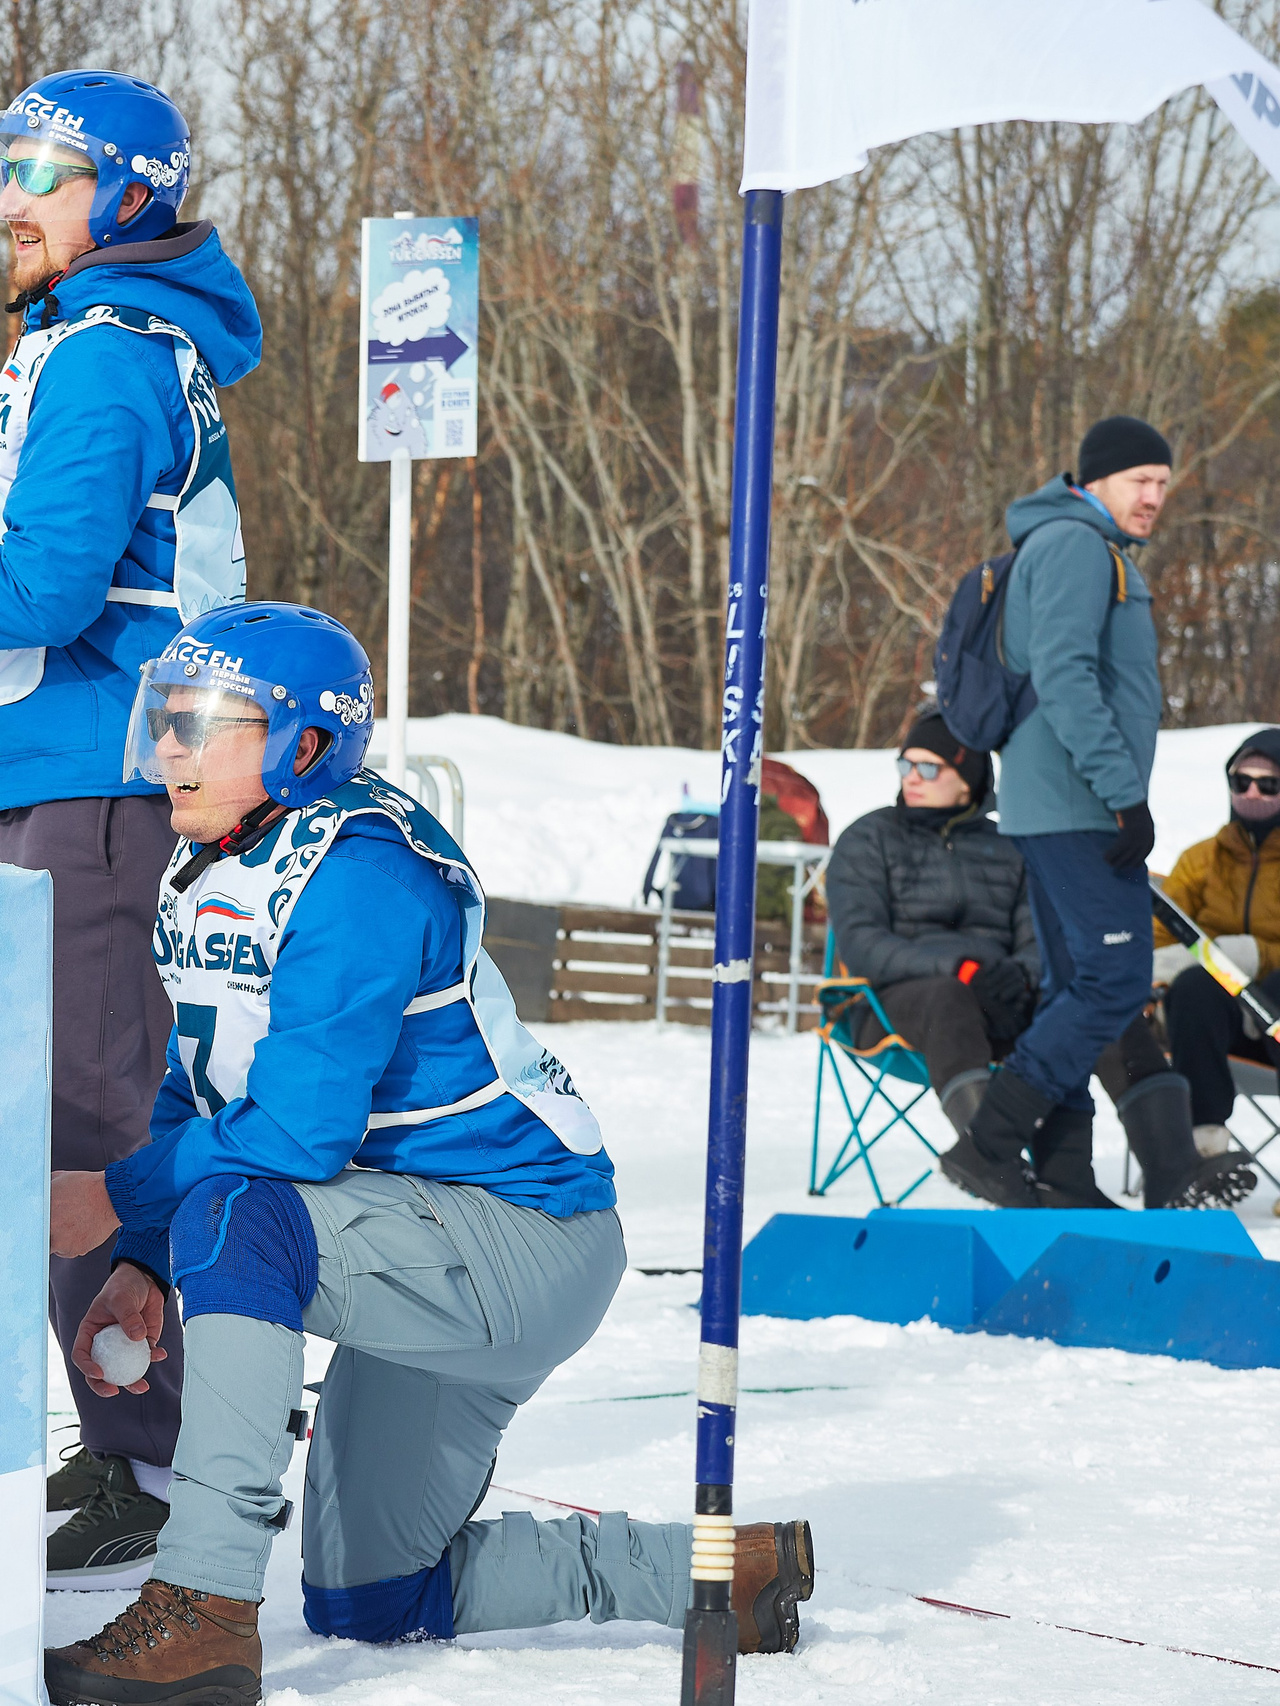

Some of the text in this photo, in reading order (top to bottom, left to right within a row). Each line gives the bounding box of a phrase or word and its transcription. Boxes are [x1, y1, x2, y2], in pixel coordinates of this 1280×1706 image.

[211, 669, 251, 685] ПЕРВЫЕ
[217, 680, 256, 697] РОССИИ
[177, 1001, 228, 1118] 7
